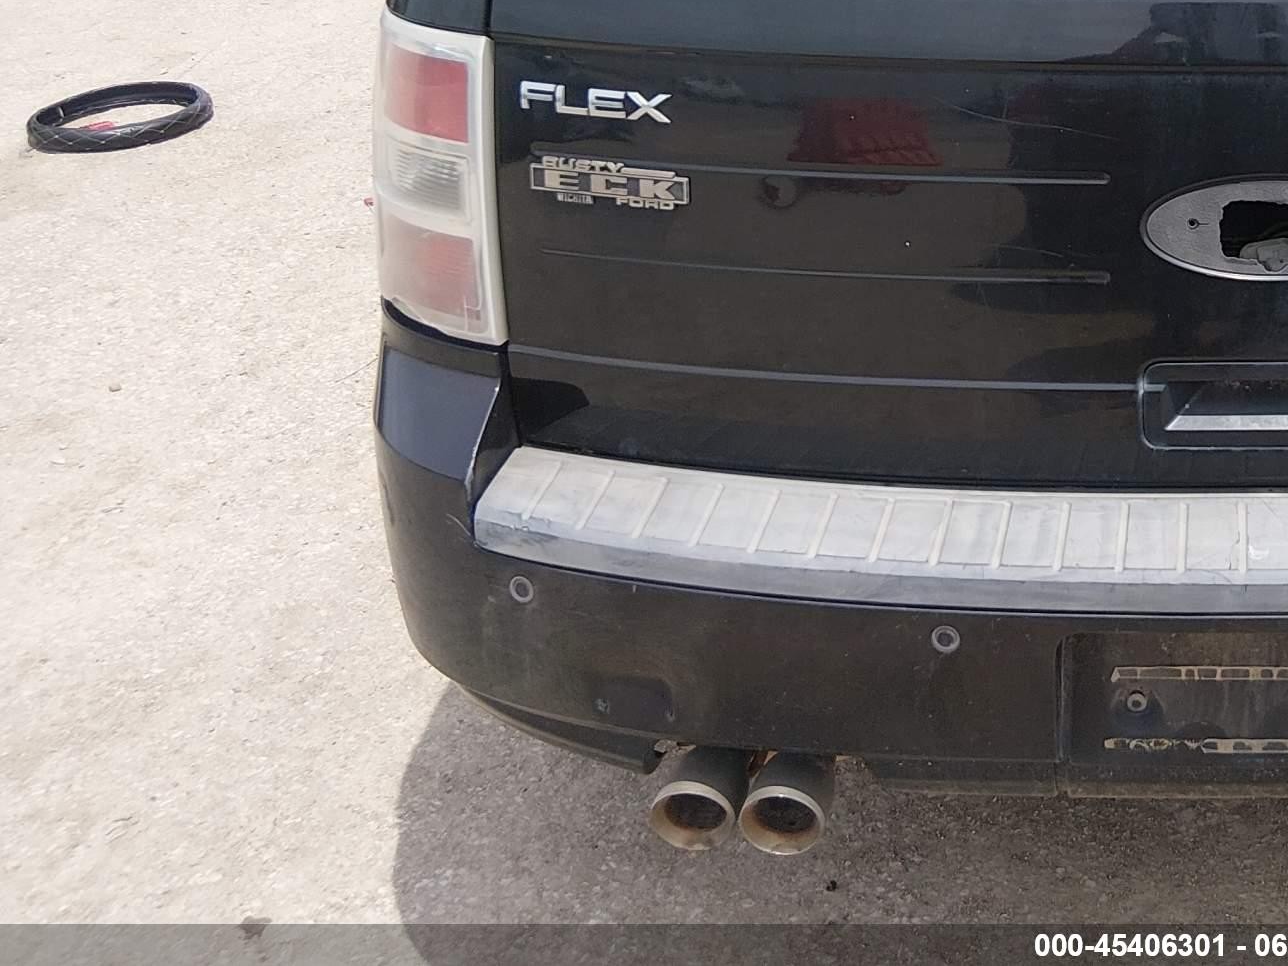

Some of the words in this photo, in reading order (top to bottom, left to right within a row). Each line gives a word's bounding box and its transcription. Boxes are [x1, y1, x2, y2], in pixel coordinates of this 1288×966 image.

[520, 81, 673, 124] FLEX
[544, 170, 676, 200] ECK
[557, 192, 594, 205] WICHITA
[616, 197, 675, 211] FORD
